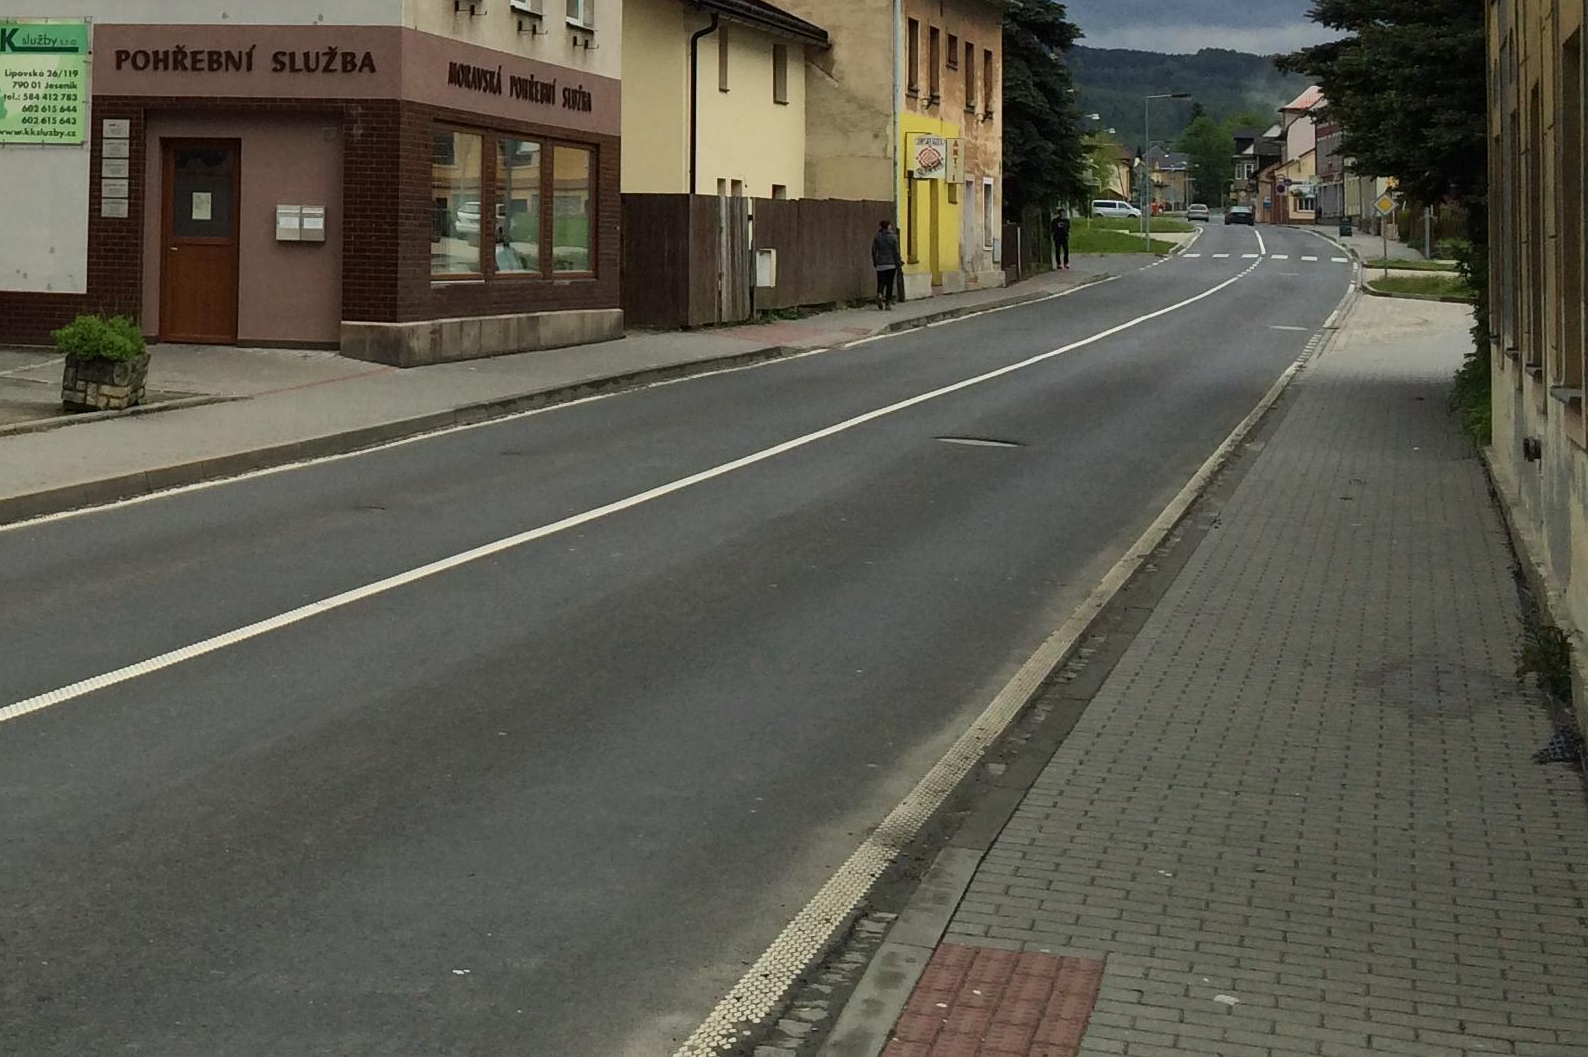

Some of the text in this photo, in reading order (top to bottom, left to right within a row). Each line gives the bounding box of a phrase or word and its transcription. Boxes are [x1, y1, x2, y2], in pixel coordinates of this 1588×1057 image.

[22, 32, 58, 48] služby
[114, 44, 377, 74] POHŘEBNÍ SLUŽBA
[47, 69, 79, 79] 26/119
[12, 81, 29, 89] 790
[31, 81, 41, 89] 01
[447, 61, 592, 112] MORAVSKÁ POHŘEBNÍ SLUŽBA
[23, 93, 41, 101] 584
[42, 93, 59, 101] 412
[22, 105, 78, 113] 602 615 644
[21, 117, 77, 125] 602 615 643
